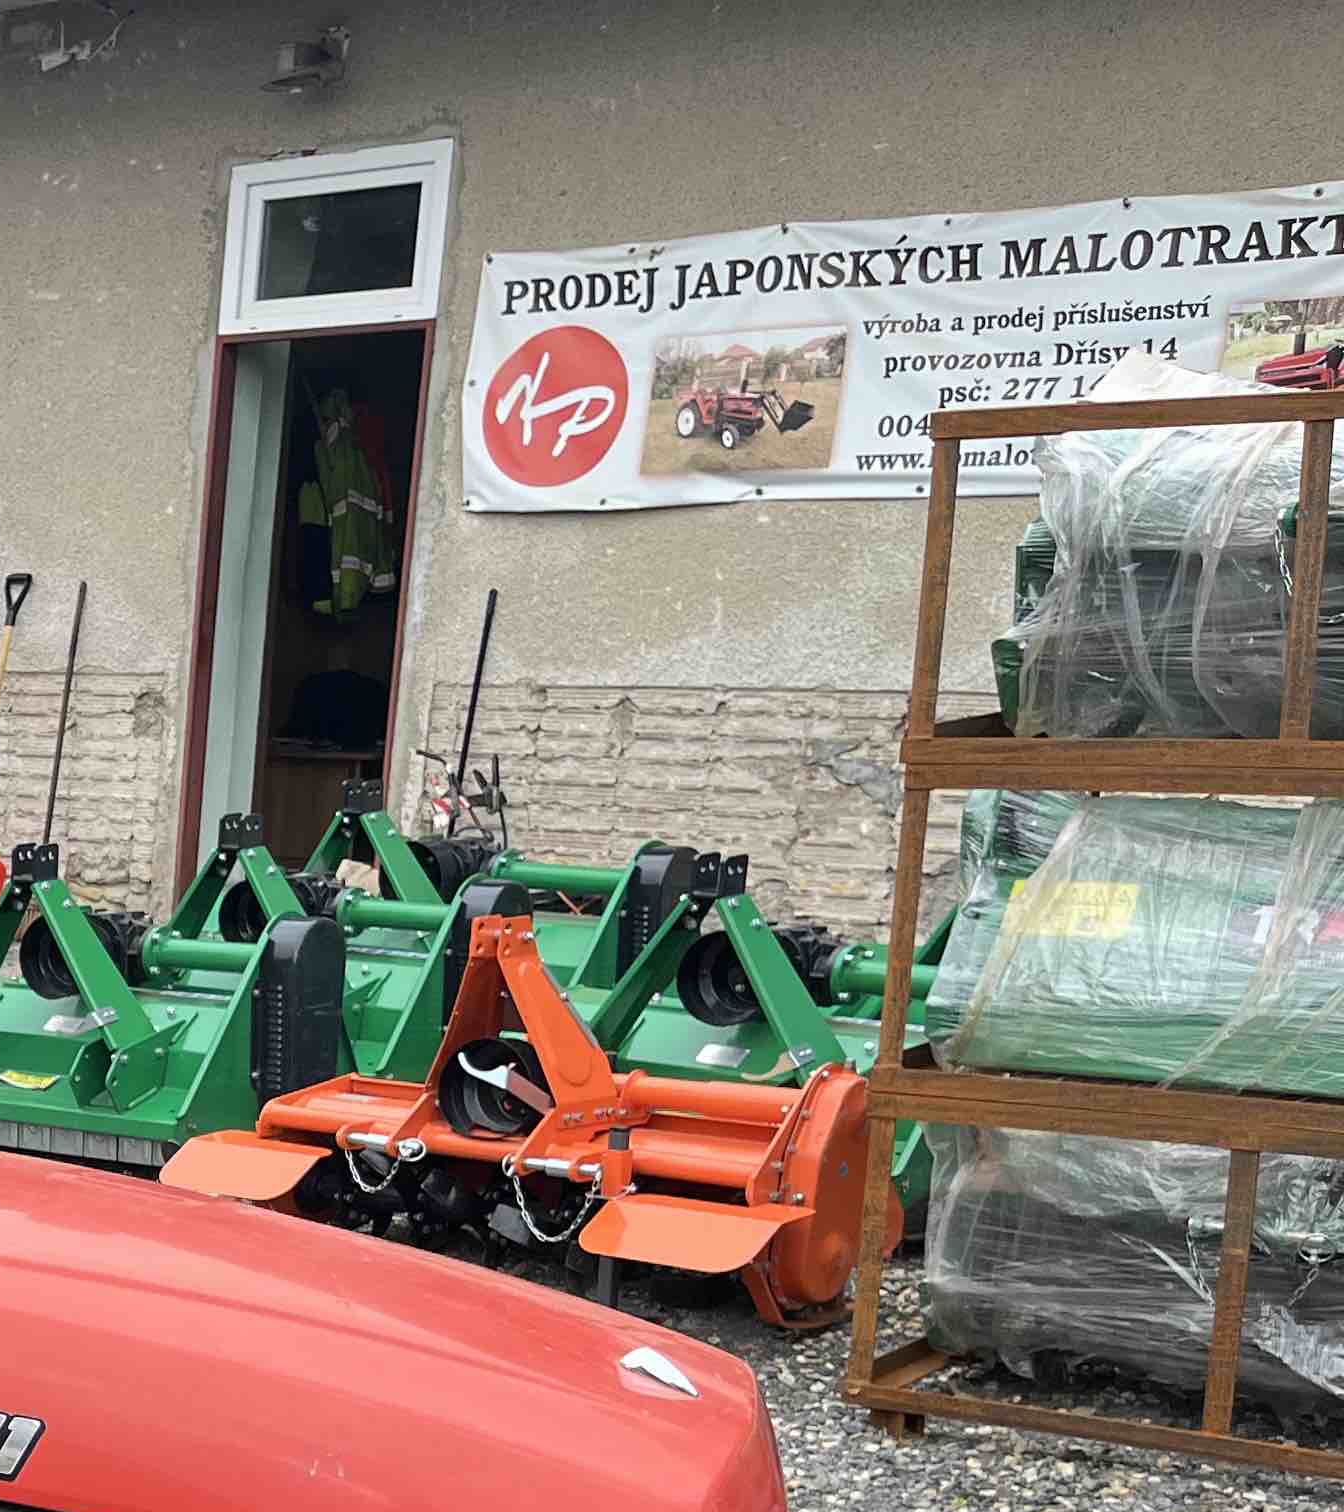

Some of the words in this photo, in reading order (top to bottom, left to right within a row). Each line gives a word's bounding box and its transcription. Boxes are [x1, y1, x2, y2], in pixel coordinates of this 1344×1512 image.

[501, 267, 659, 316] PRODEJ
[669, 235, 984, 310] JAPONSKÝCH
[999, 213, 1344, 280] MALOTRAKT
[863, 313, 942, 339] výroba
[951, 317, 965, 333] a
[972, 305, 1045, 336] prodej
[1053, 295, 1212, 332] příslušenství
[883, 352, 1042, 379] provozovna
[1053, 339, 1131, 366] Dřísy
[1142, 336, 1178, 361] 14
[938, 380, 992, 408] psč:
[1001, 377, 1061, 401] 277
[877, 413, 932, 438] 004
